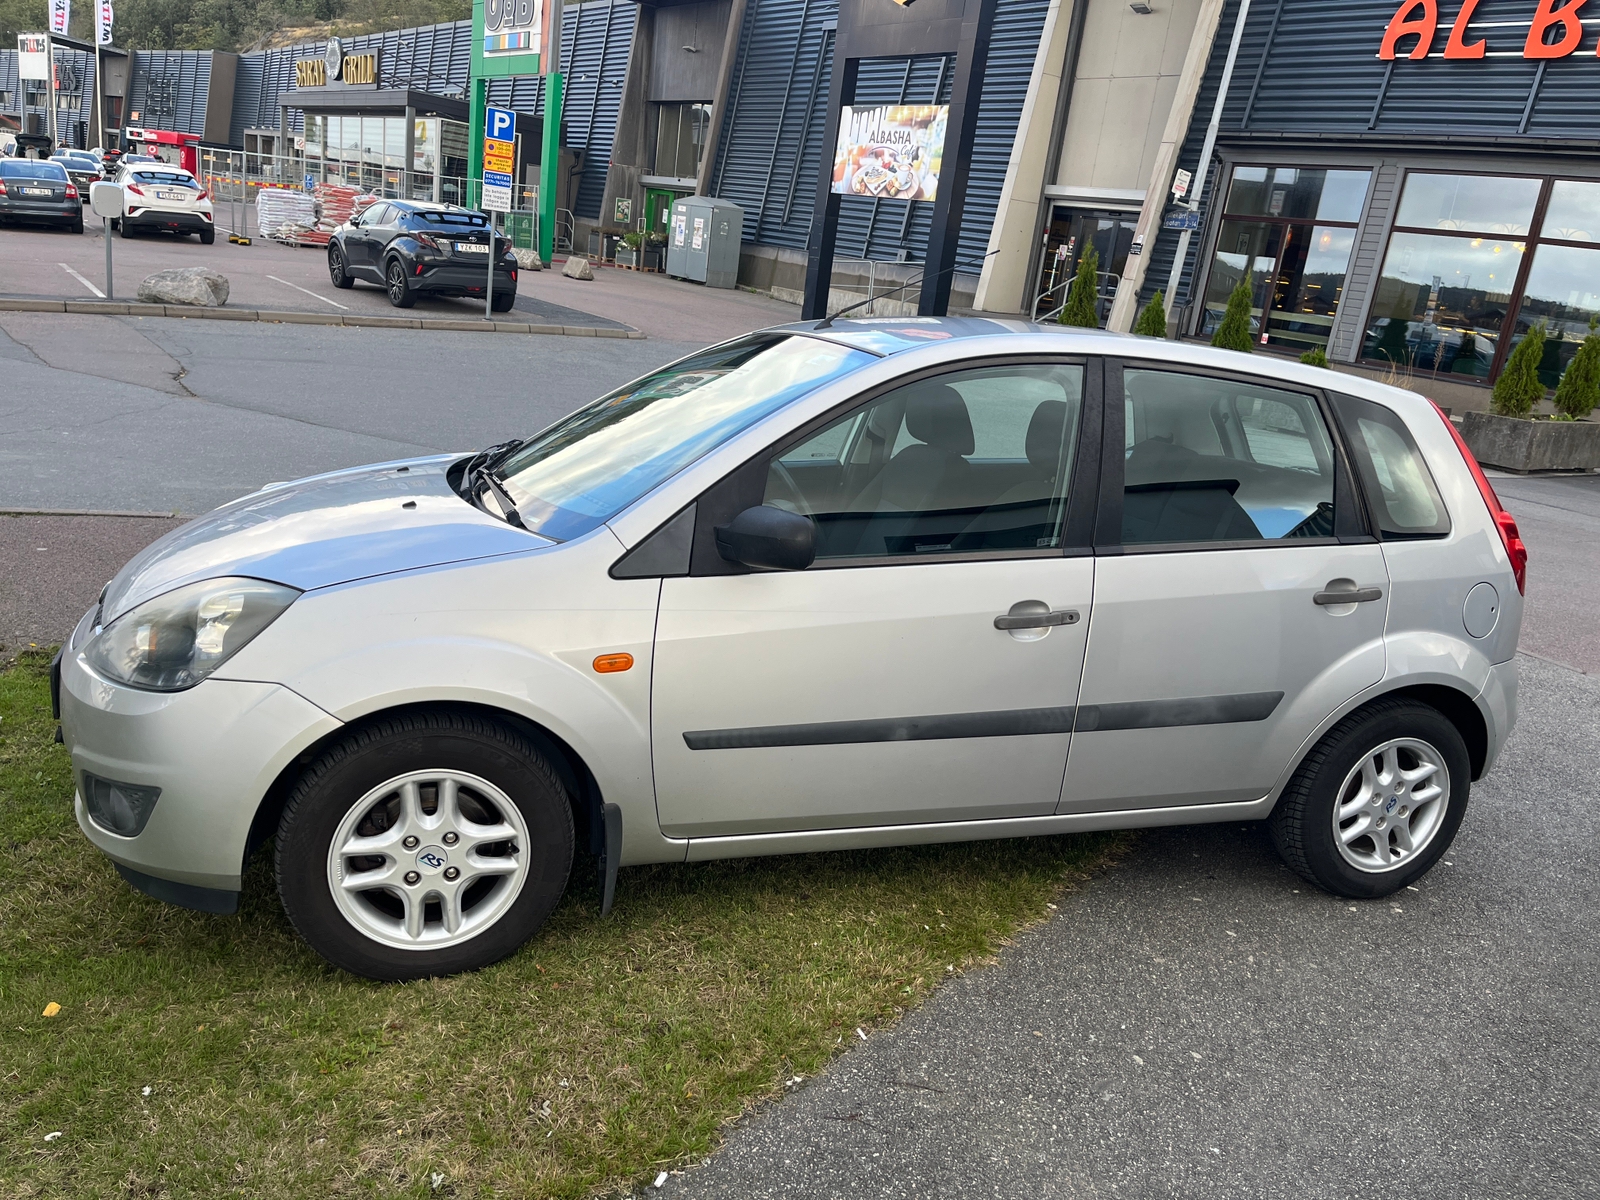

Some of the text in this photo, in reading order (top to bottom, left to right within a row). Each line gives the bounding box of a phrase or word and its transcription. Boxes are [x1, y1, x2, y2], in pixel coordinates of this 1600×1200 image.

[1522, 0, 1600, 59] B
[296, 59, 326, 87] SARAY
[342, 54, 375, 85] GRILL
[493, 111, 511, 137] P
[869, 130, 912, 144] ALBASHA
[485, 173, 510, 181] SECURITAS
[420, 853, 445, 867] RS
